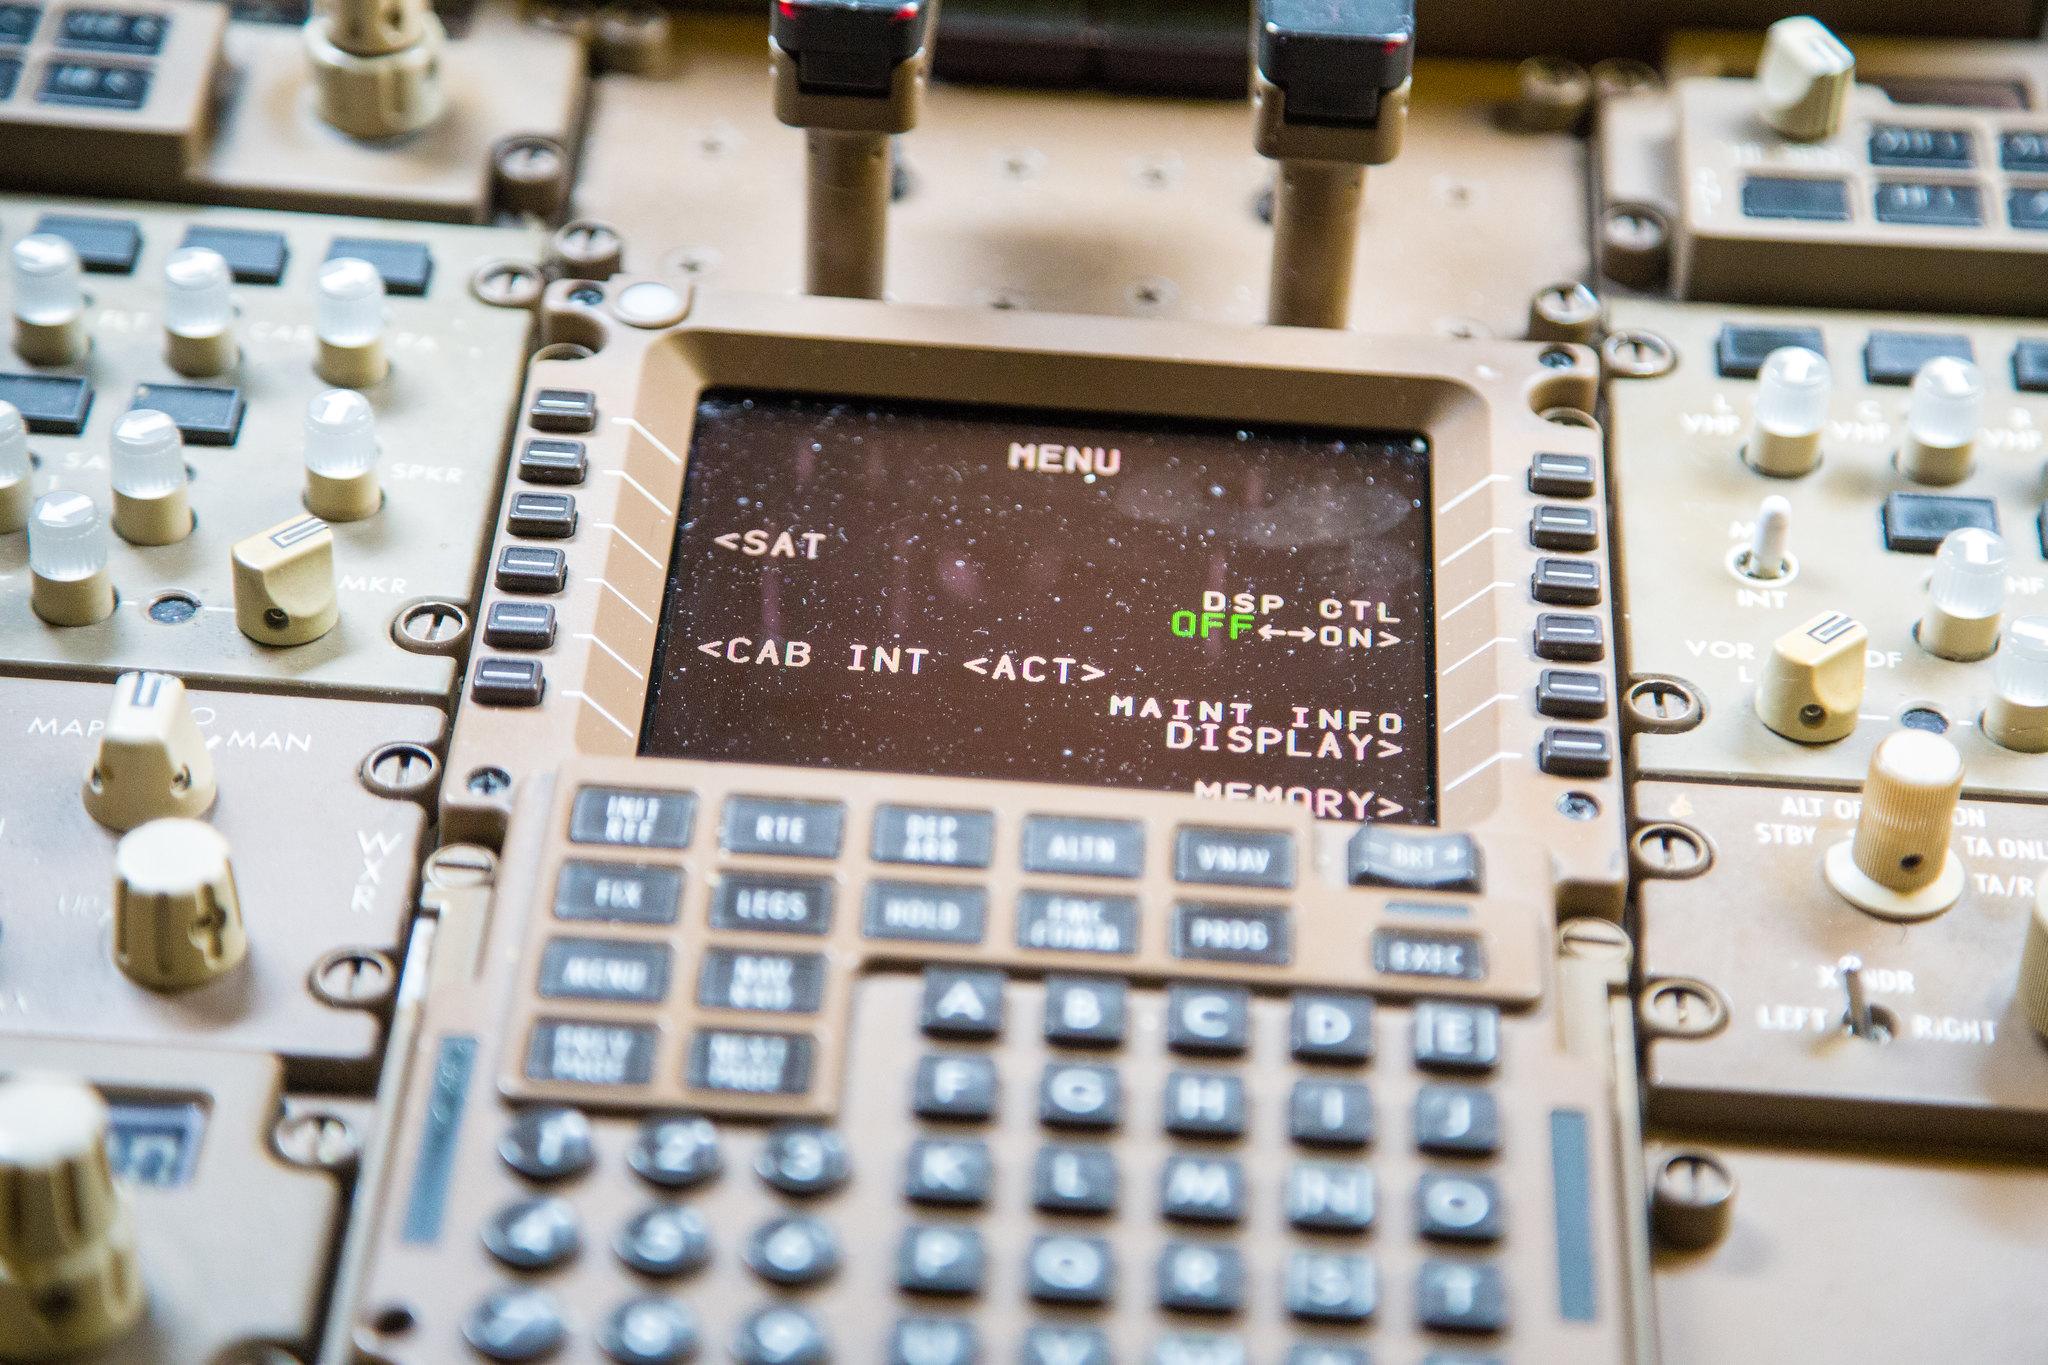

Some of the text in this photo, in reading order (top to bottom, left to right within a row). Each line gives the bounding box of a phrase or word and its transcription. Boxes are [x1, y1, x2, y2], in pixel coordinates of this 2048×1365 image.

[1829, 420, 1890, 444] VHF
[1982, 427, 2043, 451] VHF
[1009, 441, 1121, 477] MENU
[390, 462, 464, 484] SPKR
[338, 574, 406, 595] MKR
[1203, 590, 1401, 624] DSP CTL
[1735, 588, 1789, 610] INT
[1170, 610, 1256, 640] OFF
[1685, 639, 1756, 661] VOR
[1865, 651, 1902, 670] DF
[848, 644, 930, 675] INT
[963, 653, 1106, 685] <ACT>
[1109, 694, 1403, 735] MAINT INFO
[28, 716, 104, 739] MAP
[227, 729, 312, 754] MAN
[1780, 796, 1863, 820] ALT OF
[1754, 821, 1817, 846] STBY
[1961, 834, 2048, 862] TA ONL
[1972, 872, 2036, 897] TA/R
[1817, 966, 1916, 995] XNDR
[937, 980, 986, 1021] A
[1181, 995, 1230, 1039] C
[1308, 1003, 1352, 1047] D
[1755, 1004, 1831, 1033] LEFT
[1909, 1014, 1998, 1043] RIGHT
[1178, 1076, 1226, 1122] H
